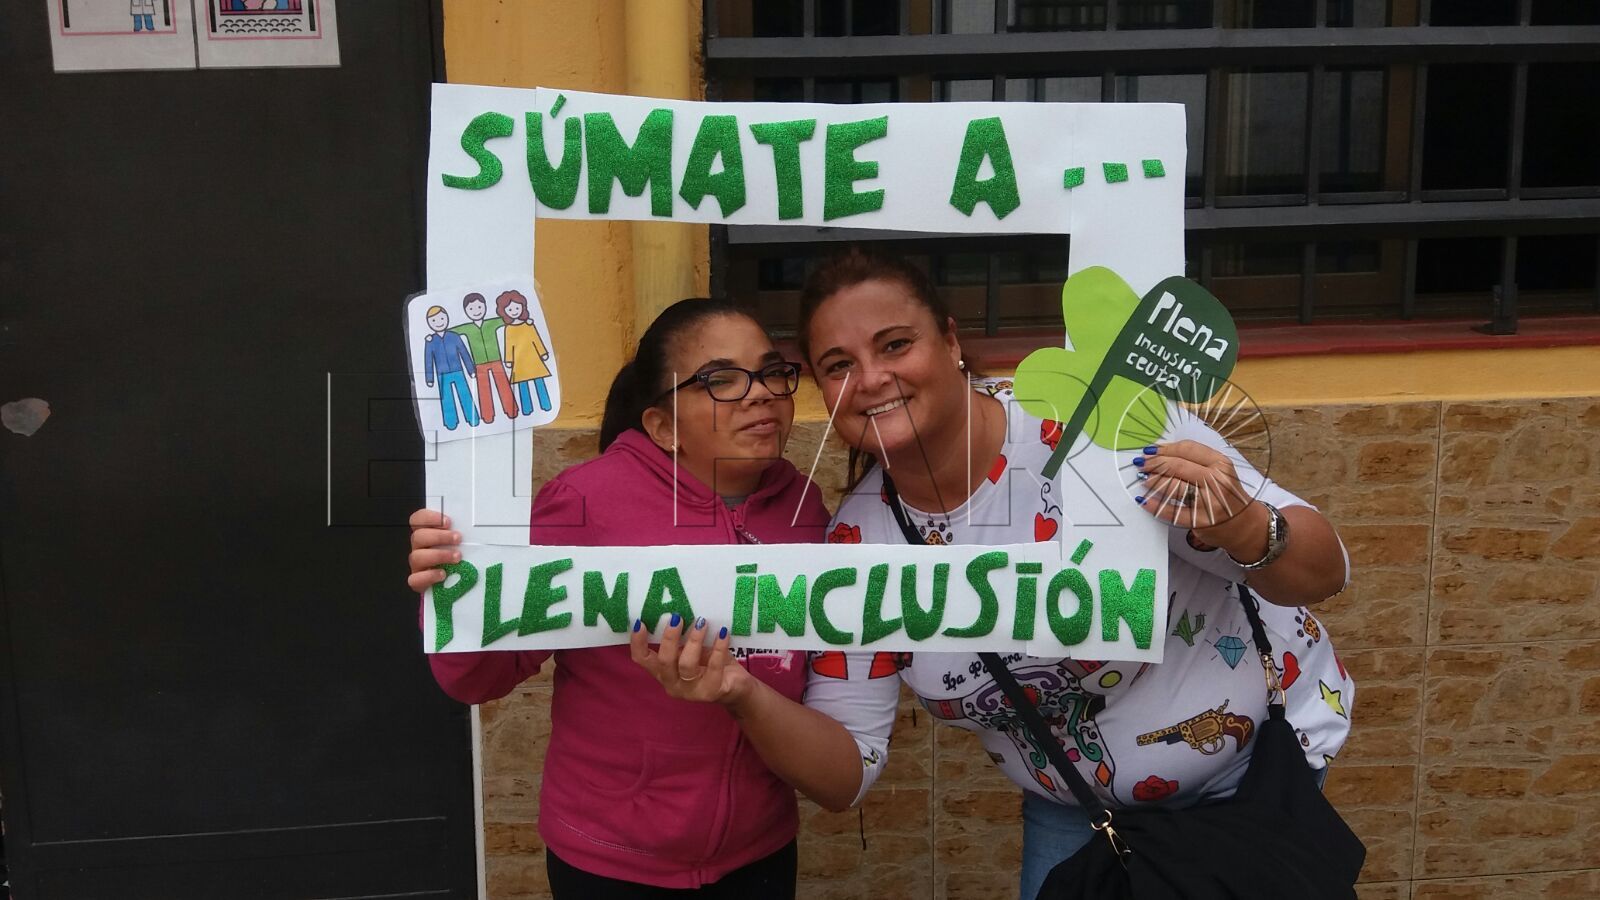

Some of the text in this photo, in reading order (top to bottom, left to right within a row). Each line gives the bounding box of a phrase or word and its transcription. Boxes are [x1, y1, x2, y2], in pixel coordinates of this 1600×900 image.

[442, 94, 888, 219] SÚMATE
[950, 117, 1020, 220] A
[1147, 291, 1229, 362] Plena
[432, 558, 694, 652] PLENA
